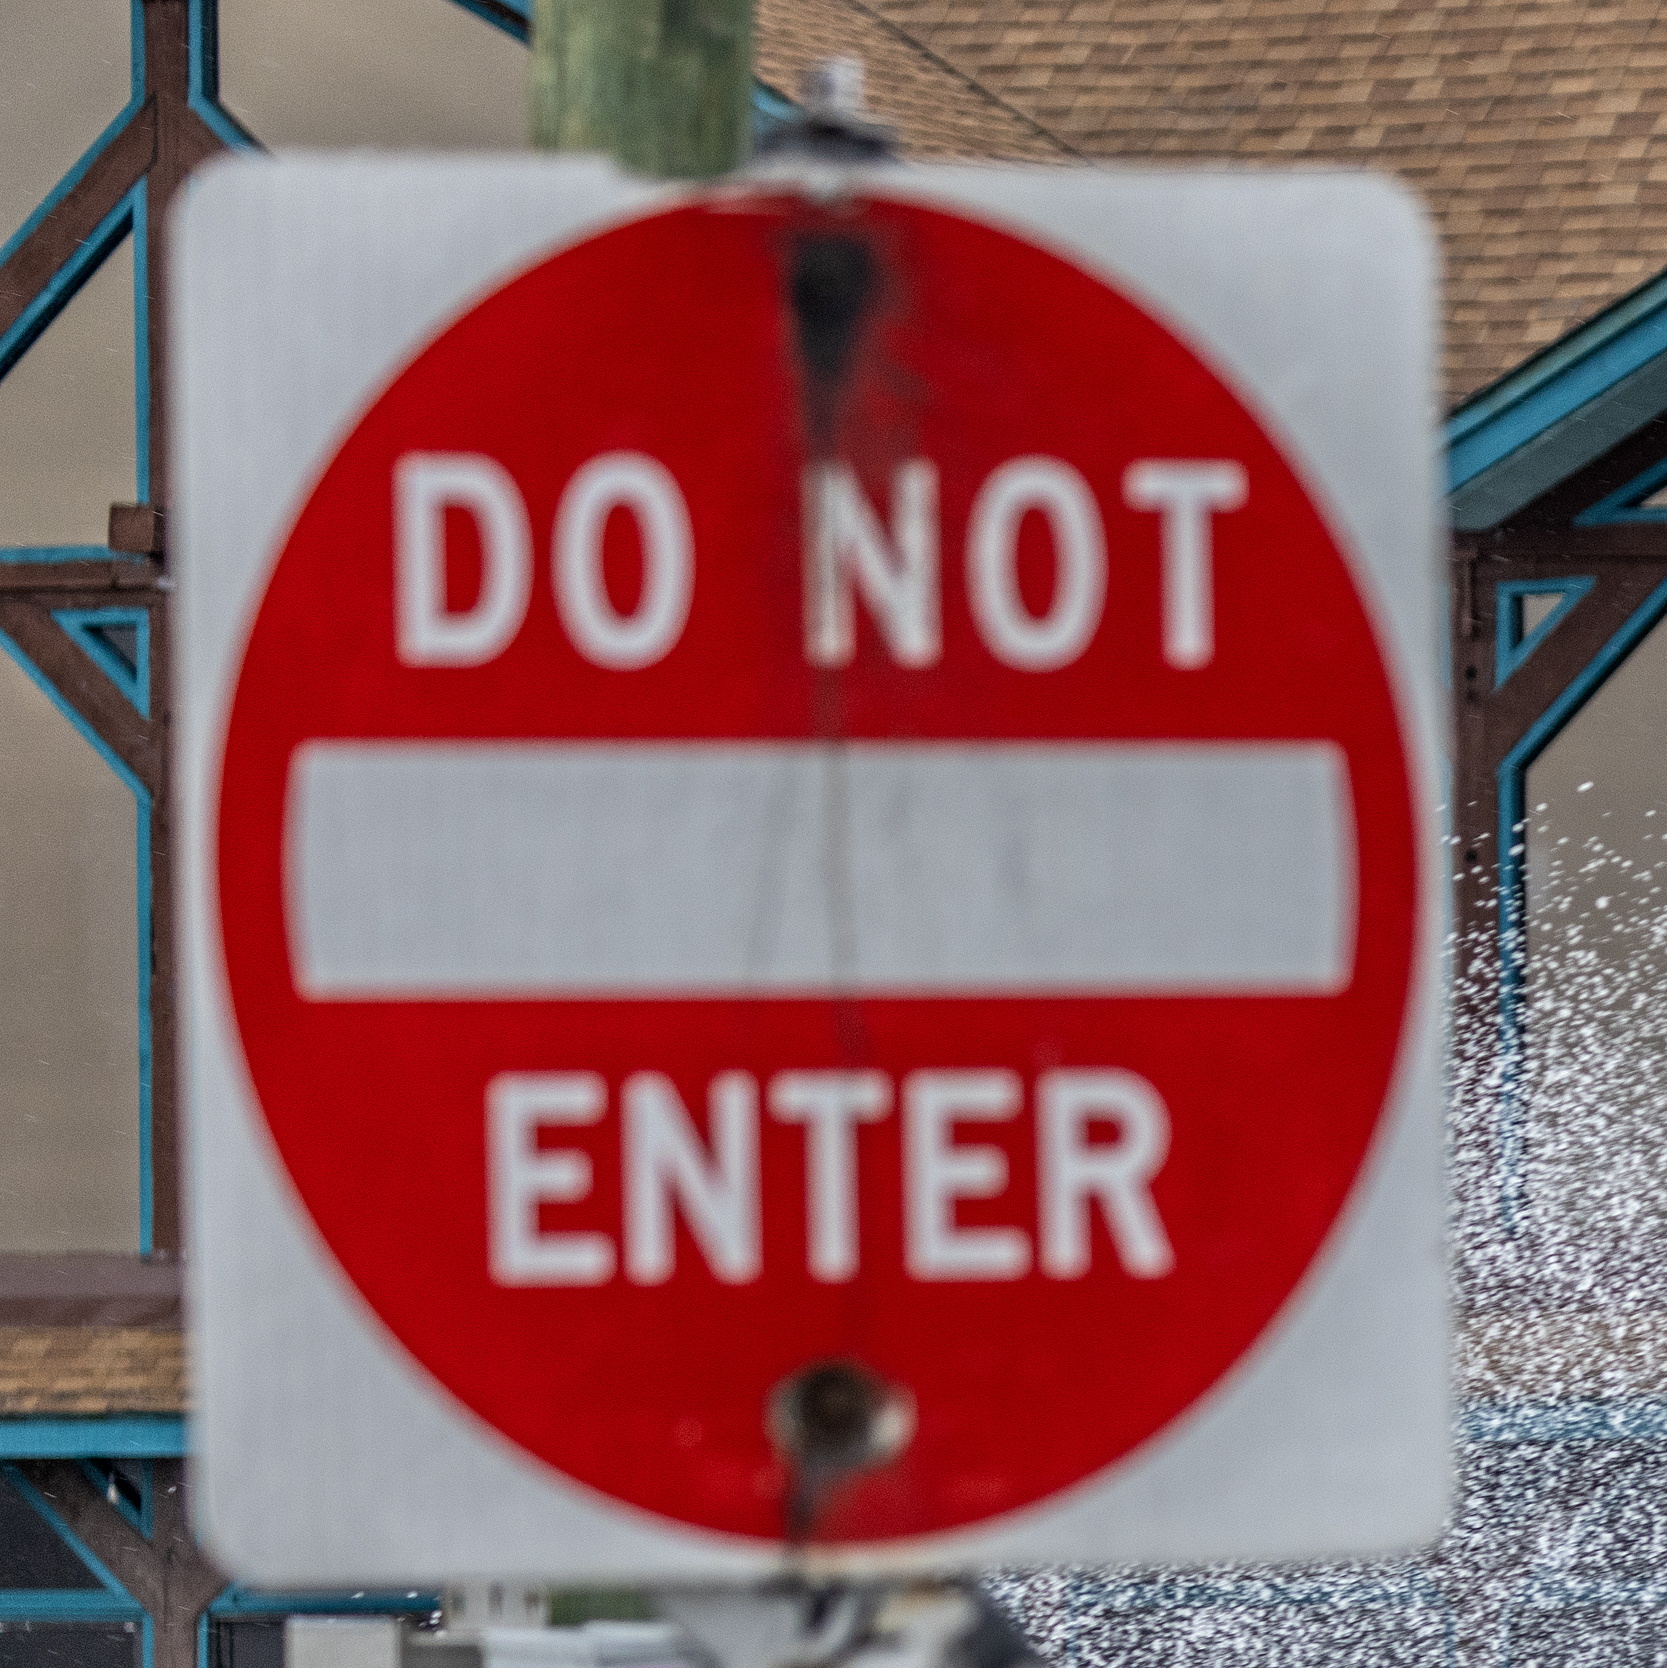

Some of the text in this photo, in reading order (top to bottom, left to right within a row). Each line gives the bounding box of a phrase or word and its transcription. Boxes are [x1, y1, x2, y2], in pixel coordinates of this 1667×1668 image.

[393, 452, 1250, 672] DO NOT
[484, 1066, 1176, 1286] ENTER
